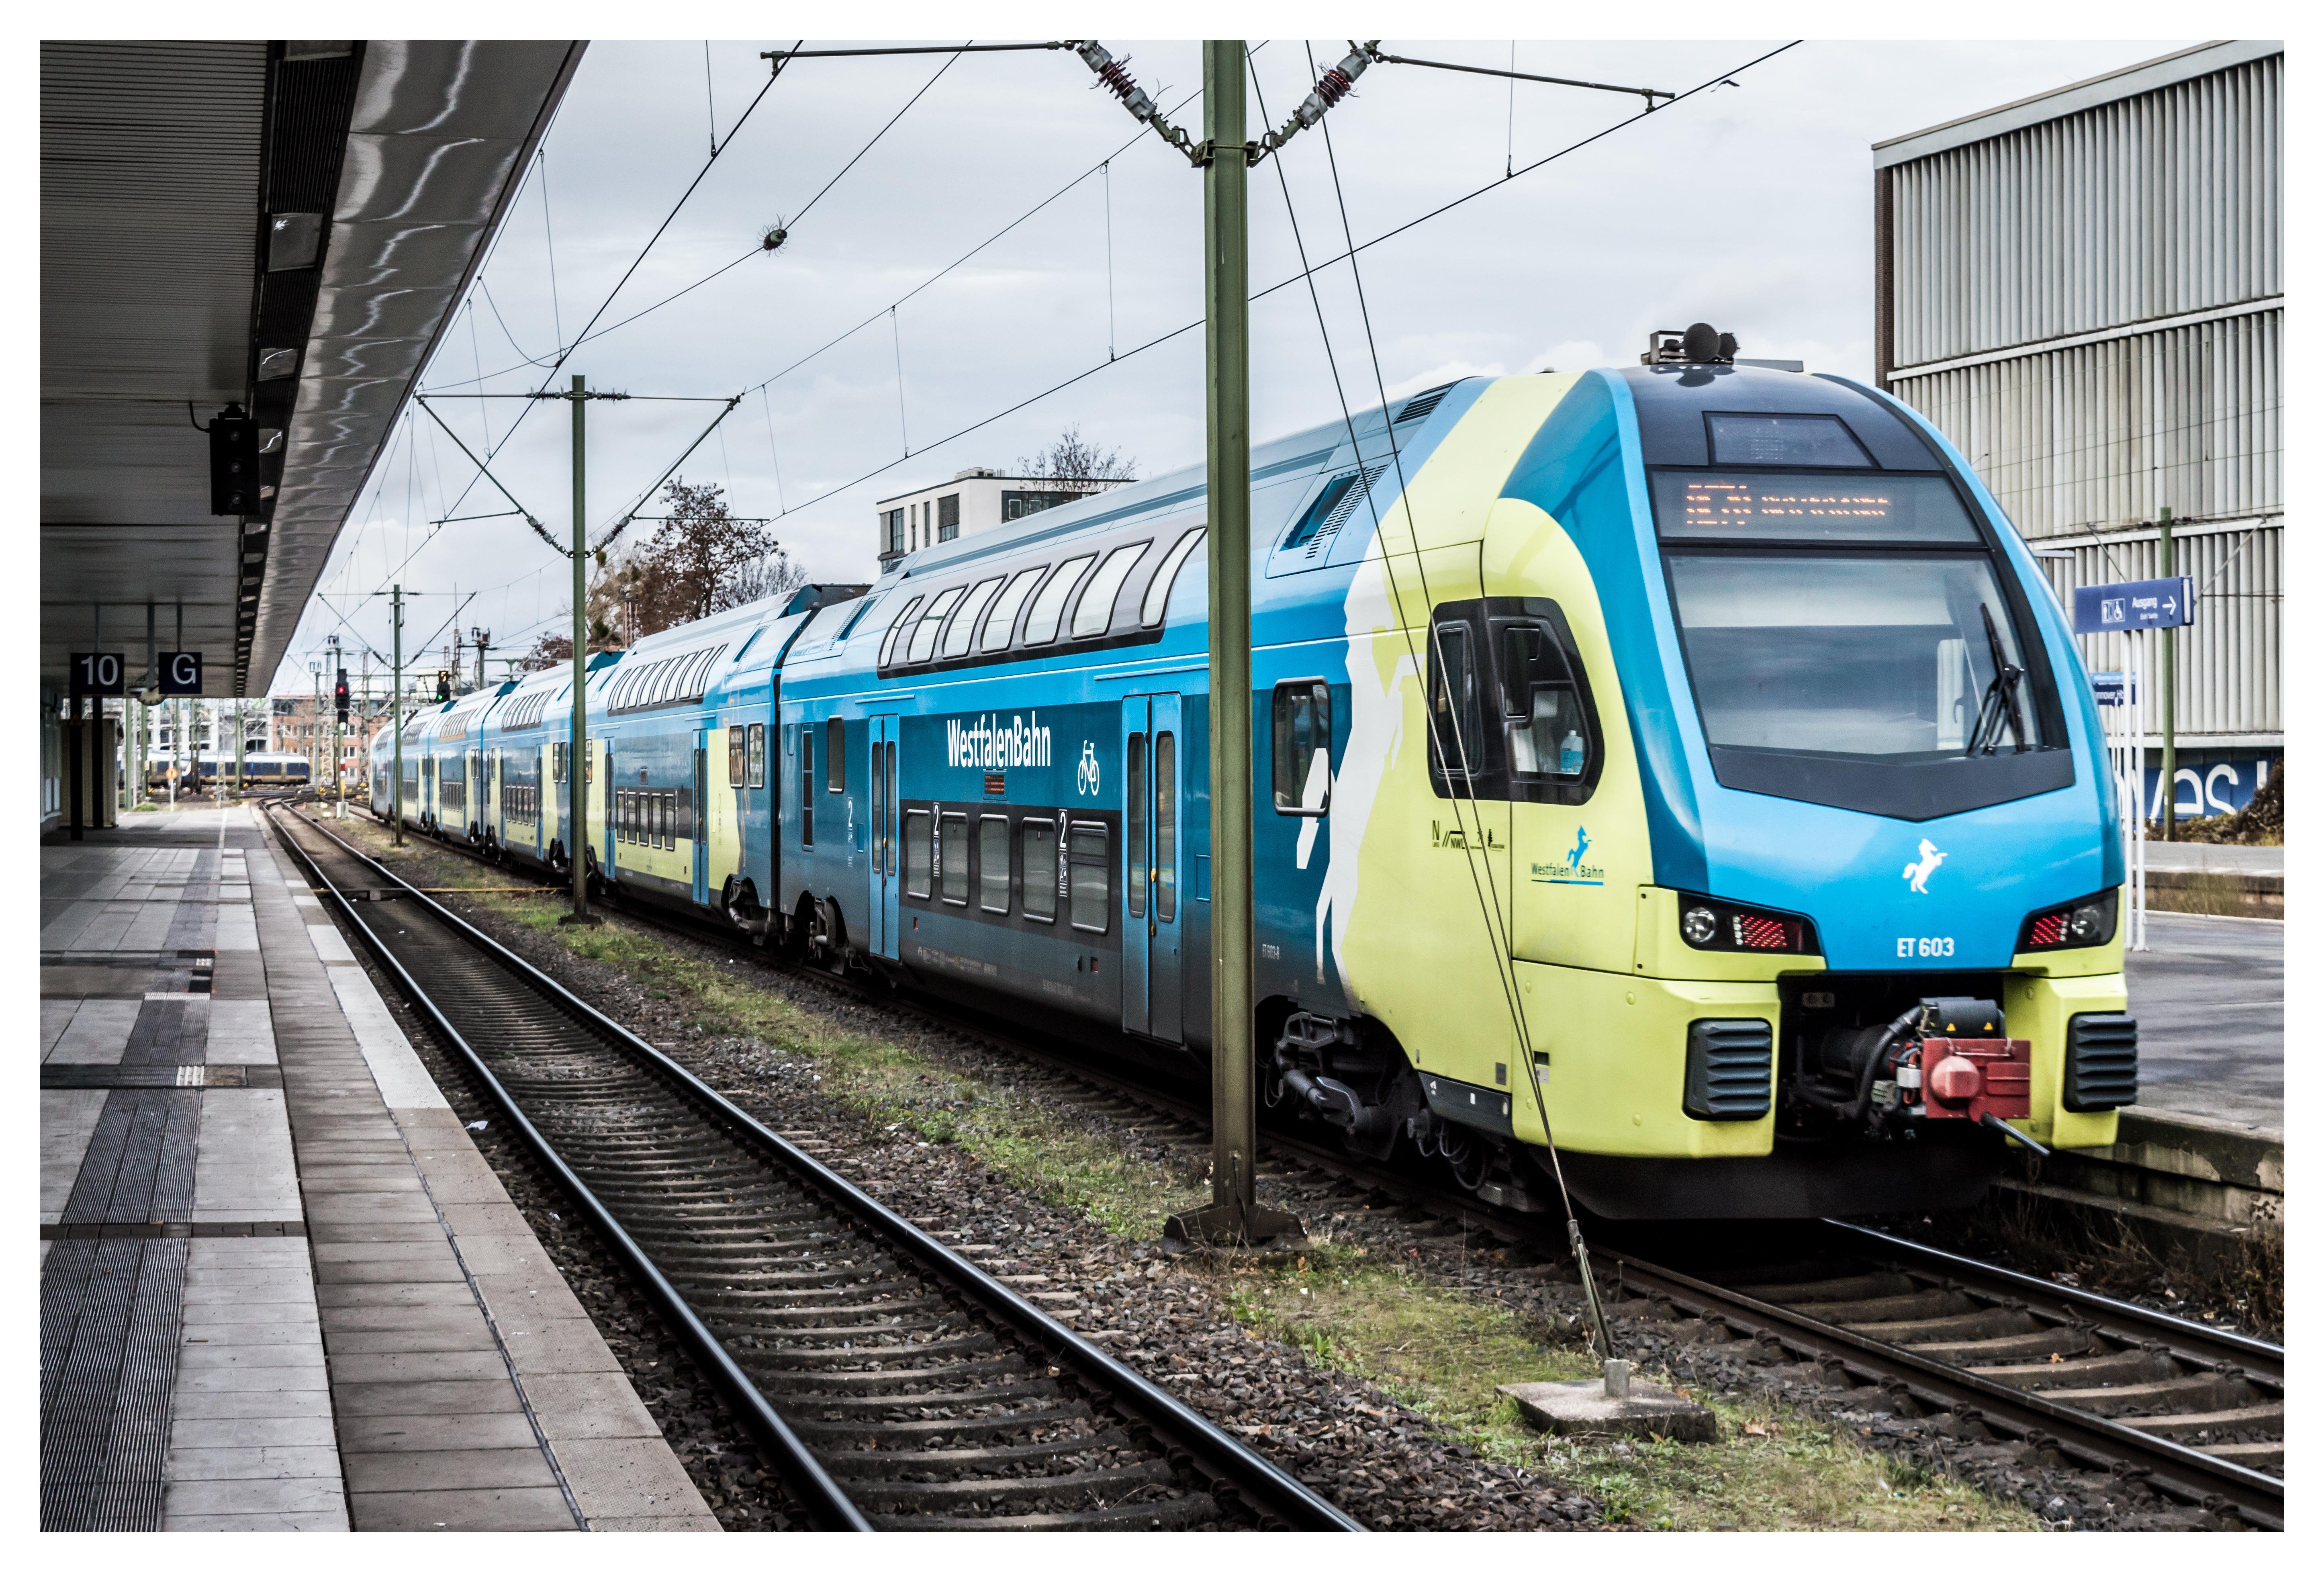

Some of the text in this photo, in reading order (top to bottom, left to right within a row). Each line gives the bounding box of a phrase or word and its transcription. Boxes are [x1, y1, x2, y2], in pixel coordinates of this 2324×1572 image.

[2132, 597, 2158, 609] Ausgang
[81, 655, 118, 685] 10
[172, 654, 196, 685] G
[947, 710, 1051, 767] WestfalenBahn
[848, 800, 852, 827] 2
[934, 804, 939, 835] 2
[1060, 812, 1066, 848] 2
[1531, 863, 1604, 878] Westfalen Bahn
[1897, 937, 1955, 958] ET 603
